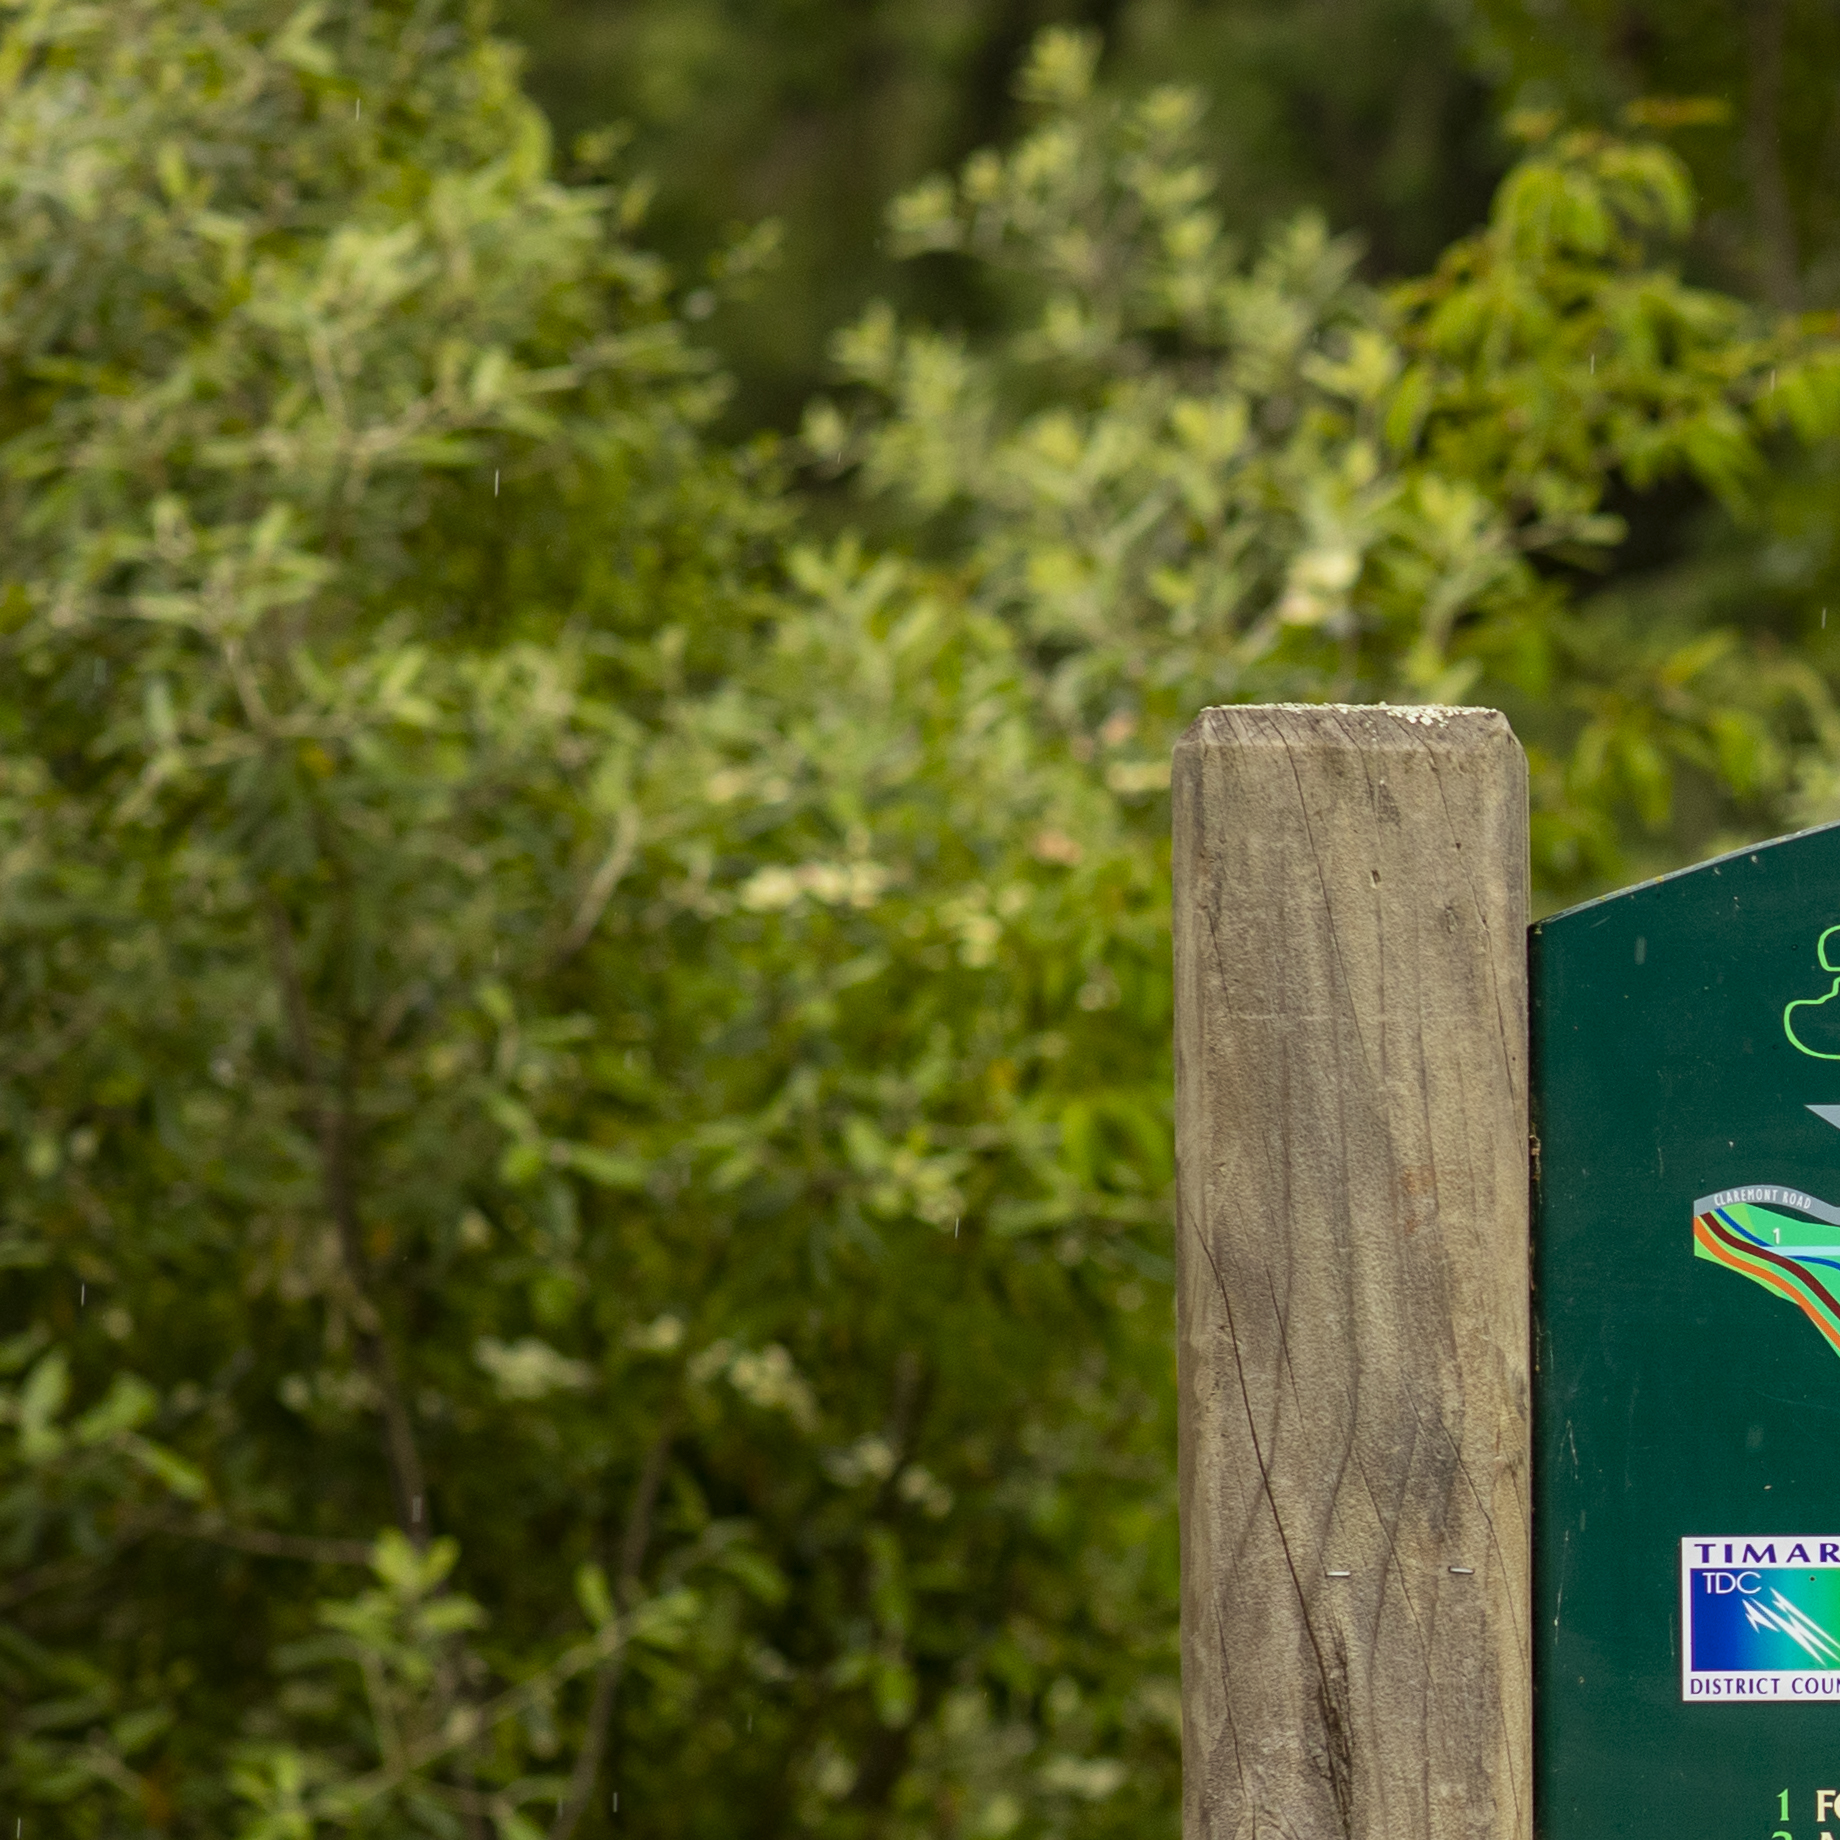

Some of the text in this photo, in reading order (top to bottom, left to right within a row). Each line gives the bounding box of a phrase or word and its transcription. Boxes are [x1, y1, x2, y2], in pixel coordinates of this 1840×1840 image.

[1713, 1188, 1812, 1210] CLAREMONT ROAD
[1772, 1227, 1781, 1245] 1
[1702, 1571, 1762, 1595] TDC
[1690, 1677, 1780, 1695] DISTRICT
[1776, 1789, 1790, 1821] 1
